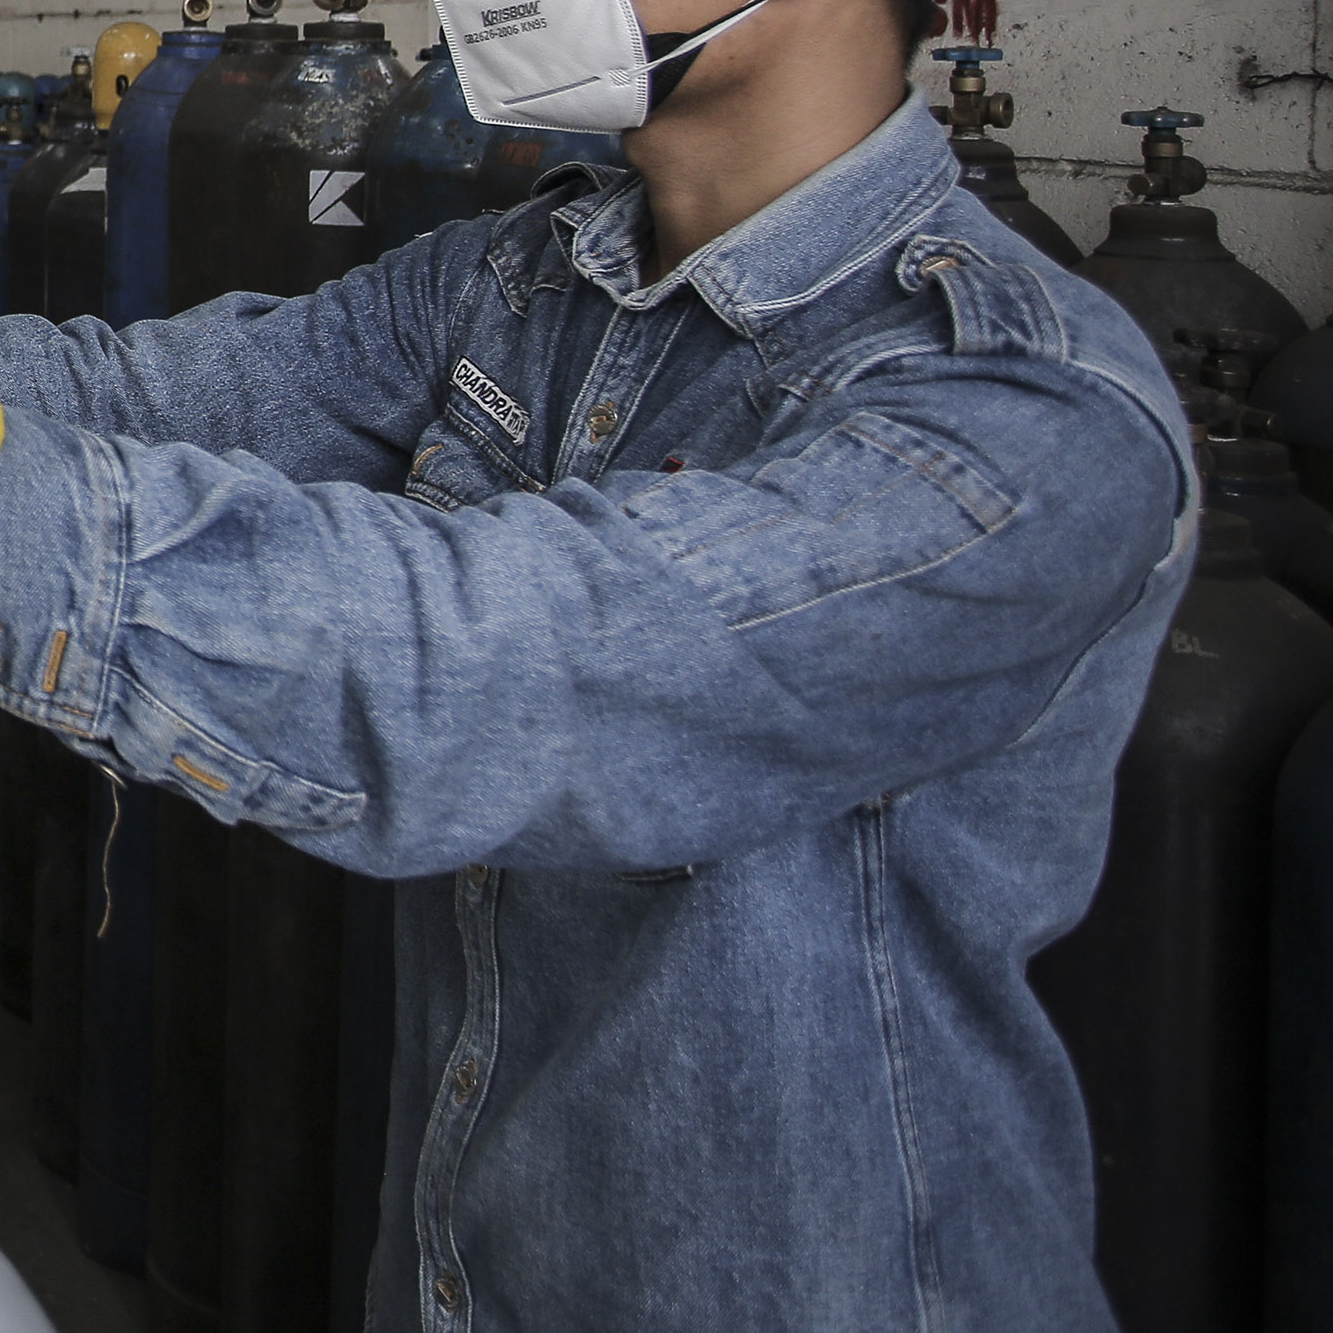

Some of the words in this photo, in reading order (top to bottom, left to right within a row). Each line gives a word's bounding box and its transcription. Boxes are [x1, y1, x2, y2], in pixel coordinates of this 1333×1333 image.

[481, 0, 541, 27] KRISBOW
[464, 25, 519, 44] GB2626-2006
[521, 18, 547, 32] KN95
[456, 363, 513, 422] CHANDRA
